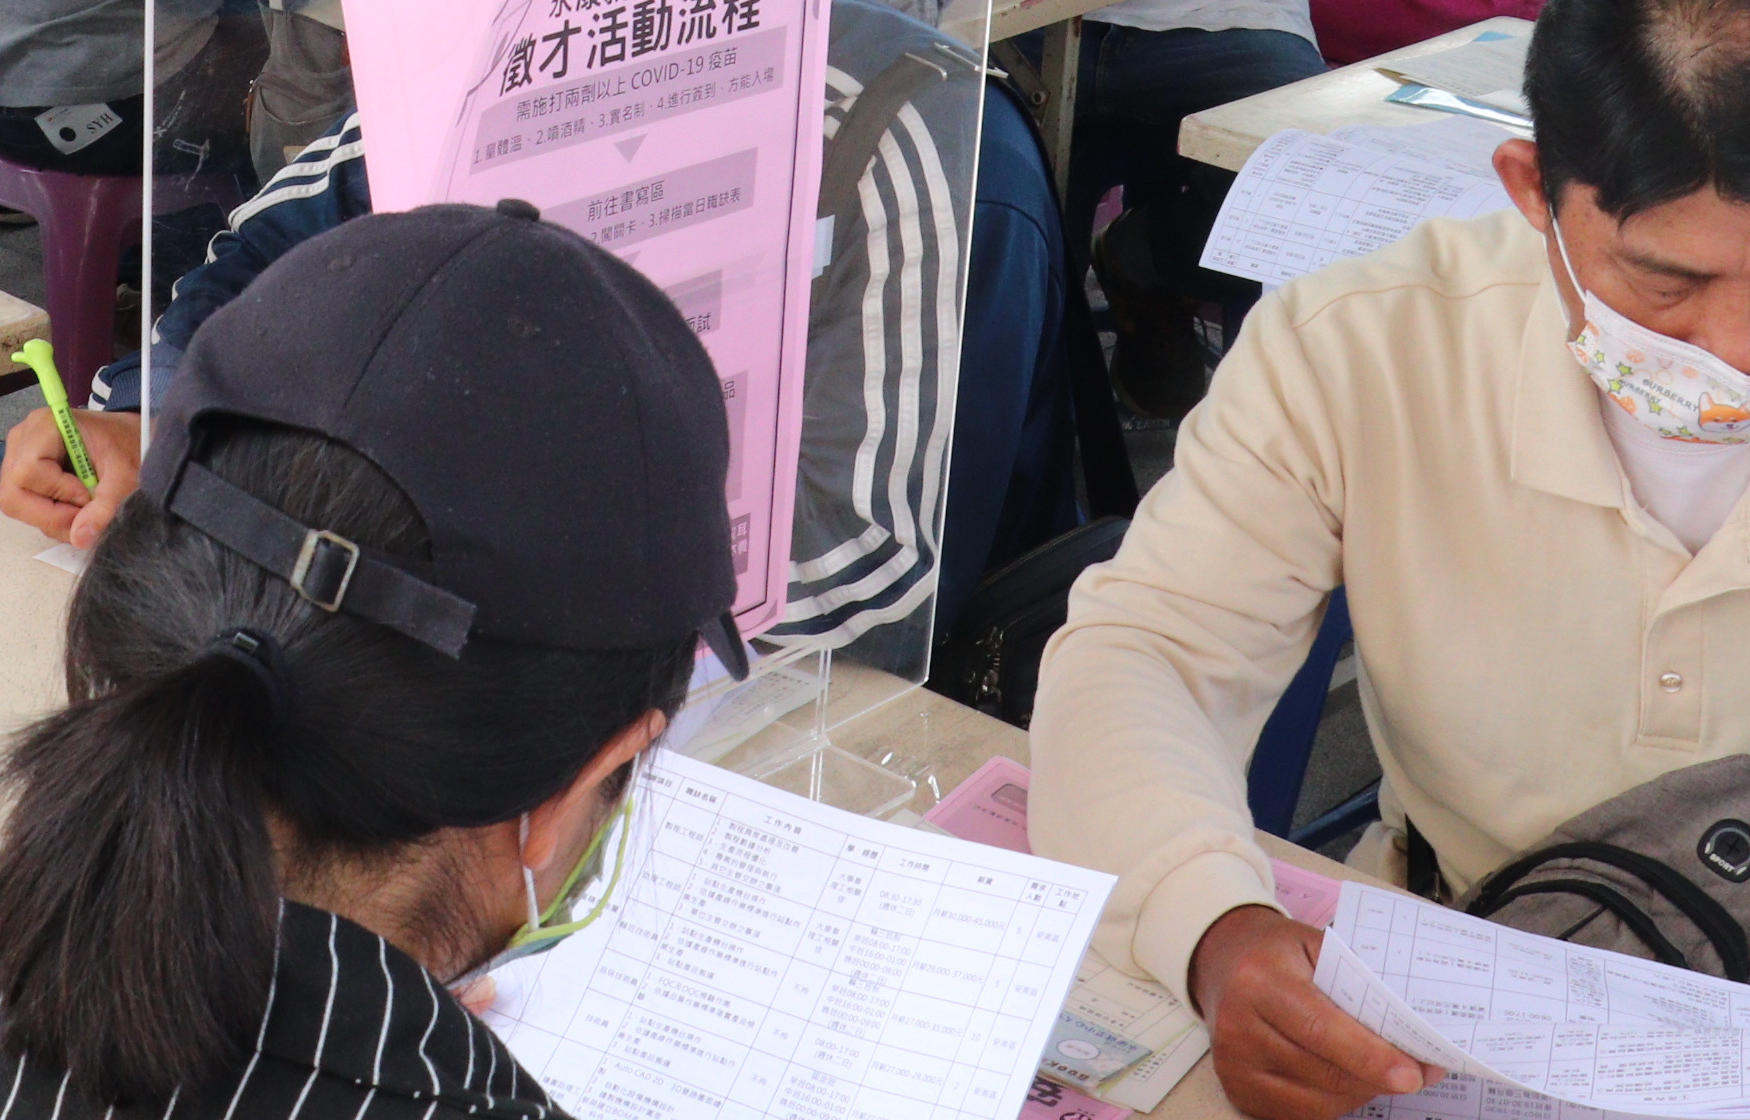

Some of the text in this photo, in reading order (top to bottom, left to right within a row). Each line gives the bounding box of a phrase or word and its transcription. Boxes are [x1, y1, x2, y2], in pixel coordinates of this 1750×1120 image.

[517, 47, 738, 122] 需施打兩劑以上 COVID-19 疫苗
[587, 180, 665, 222] 前往書寫區
[1642, 379, 1699, 412] BURBERRY
[1709, 853, 1736, 873] SPORT
